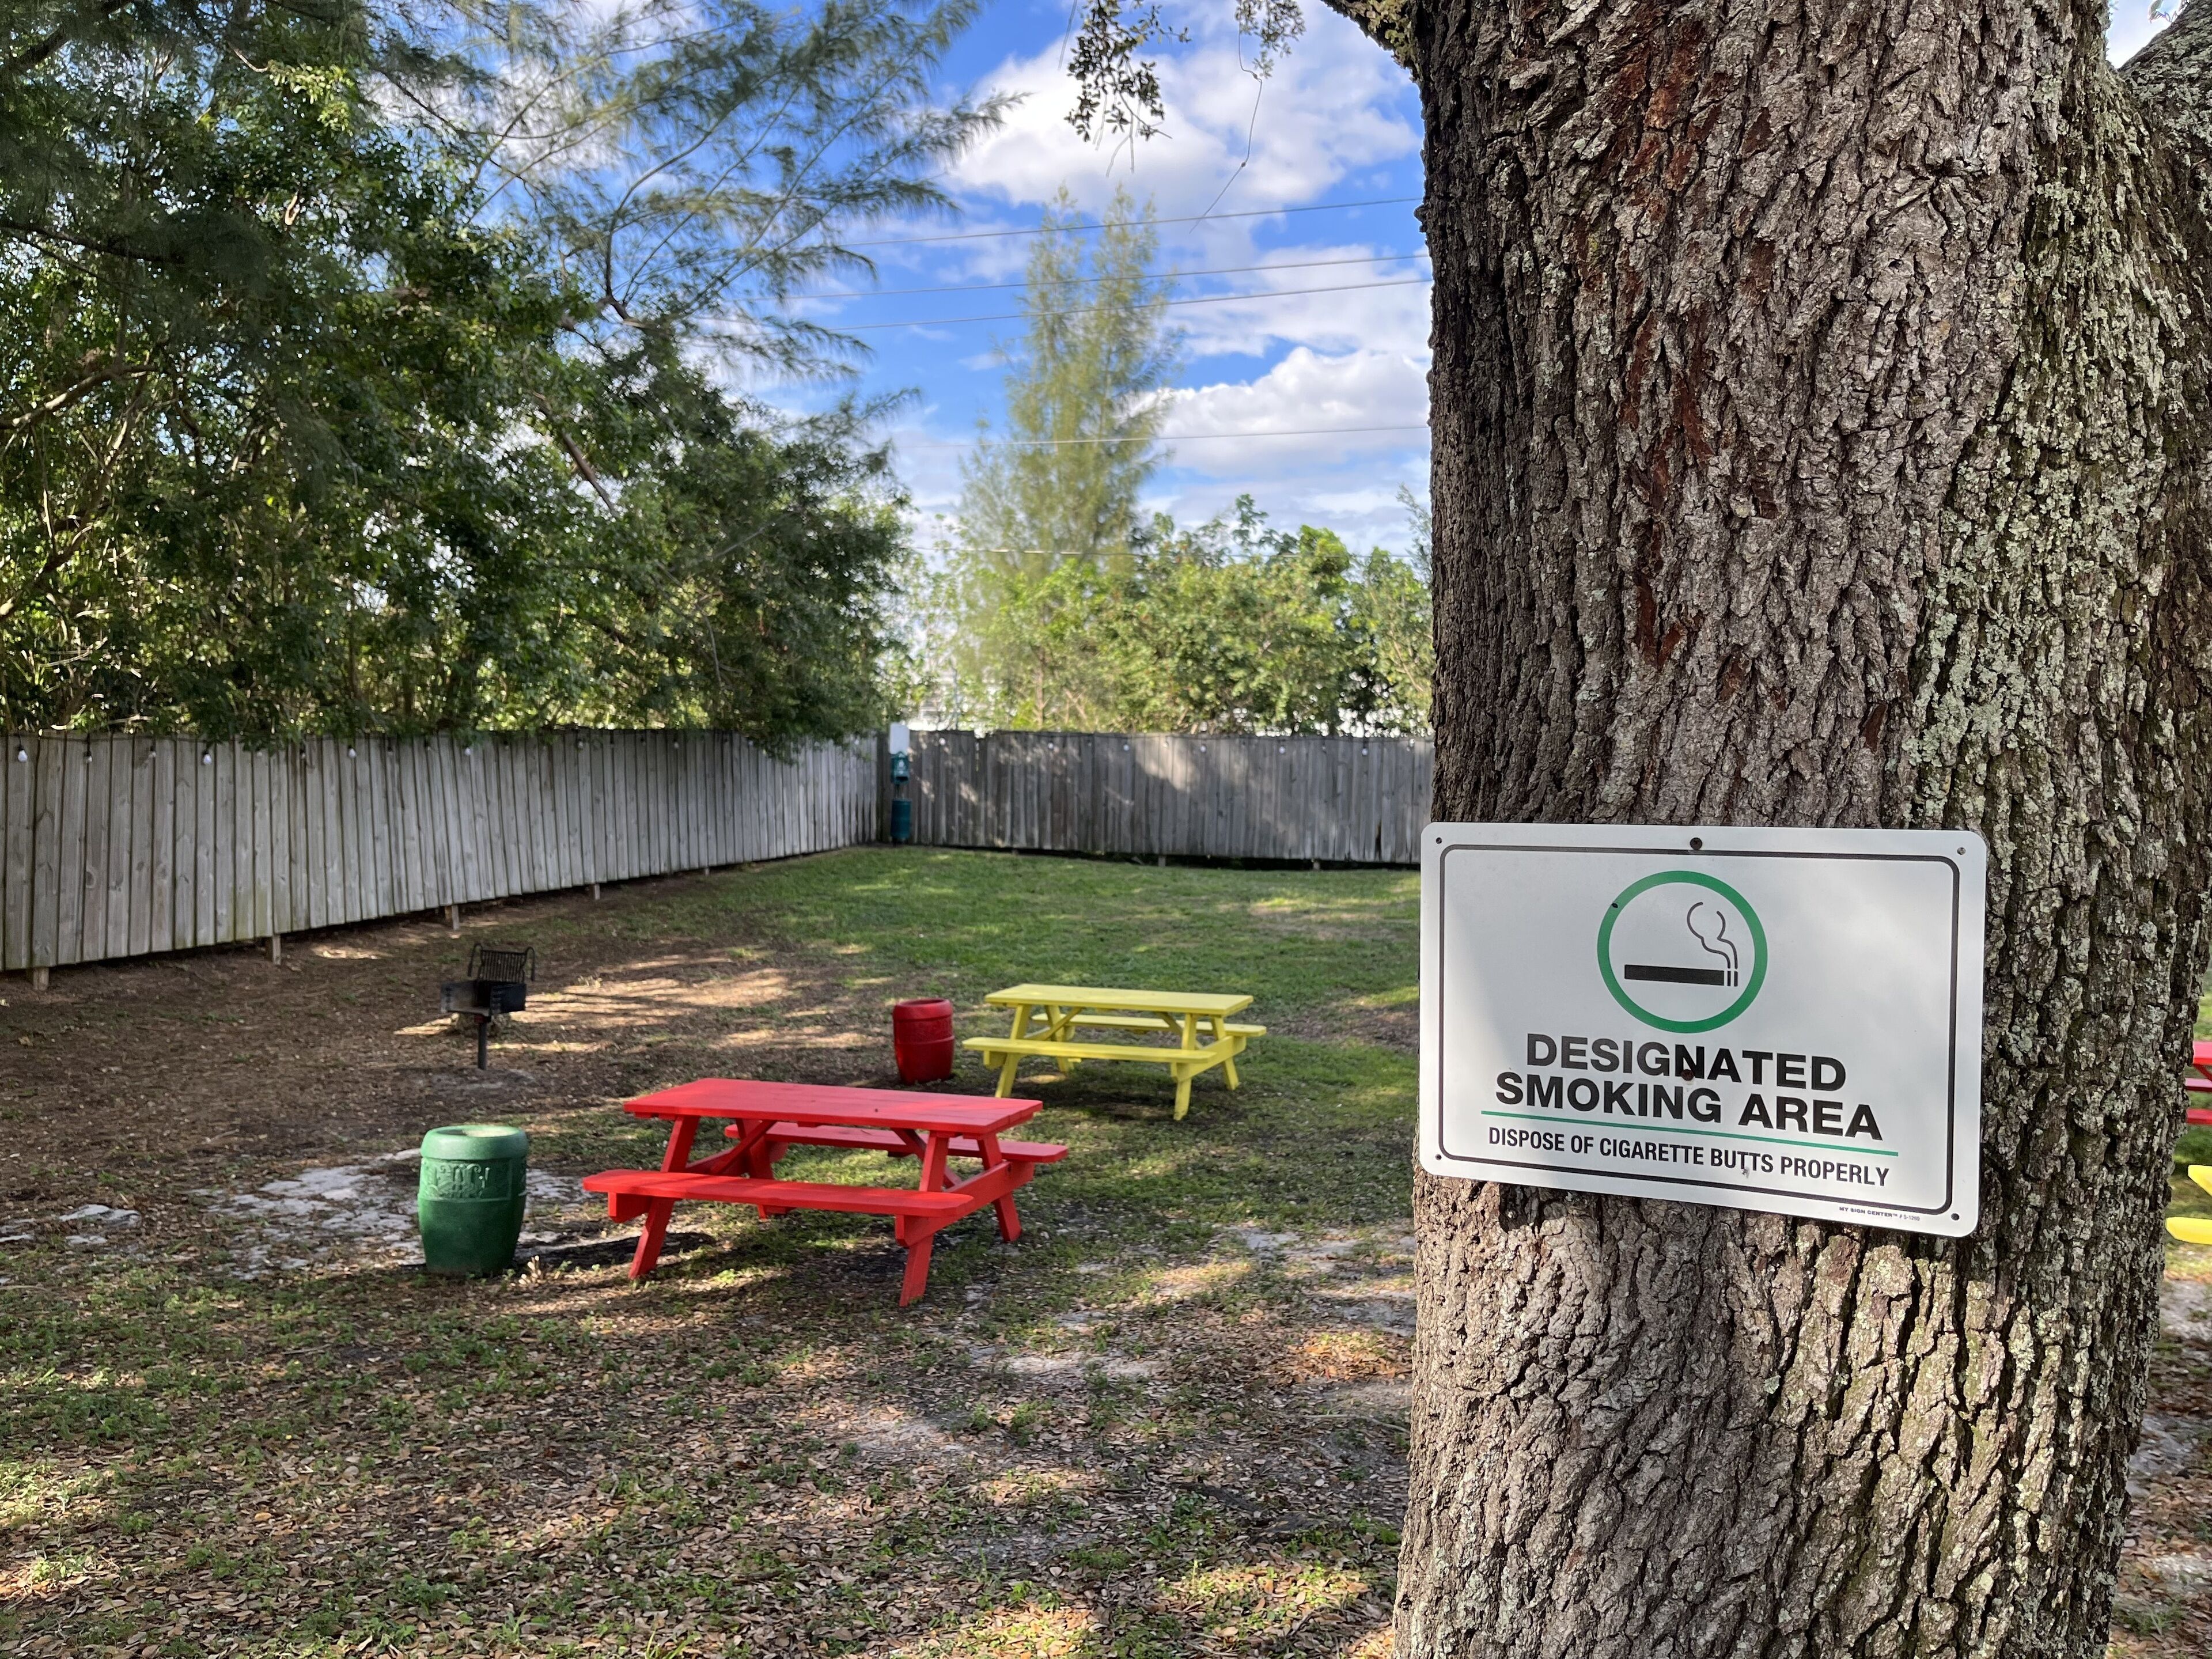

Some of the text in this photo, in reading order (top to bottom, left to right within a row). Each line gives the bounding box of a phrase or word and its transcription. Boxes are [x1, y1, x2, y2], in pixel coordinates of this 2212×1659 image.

[1527, 1033, 1846, 1091] DESIGNATED
[1497, 1072, 1883, 1141] SMOKING AREA
[1488, 1127, 1889, 1187] DISPOSE OF CIGARETTE BUTTS PROPERLY
